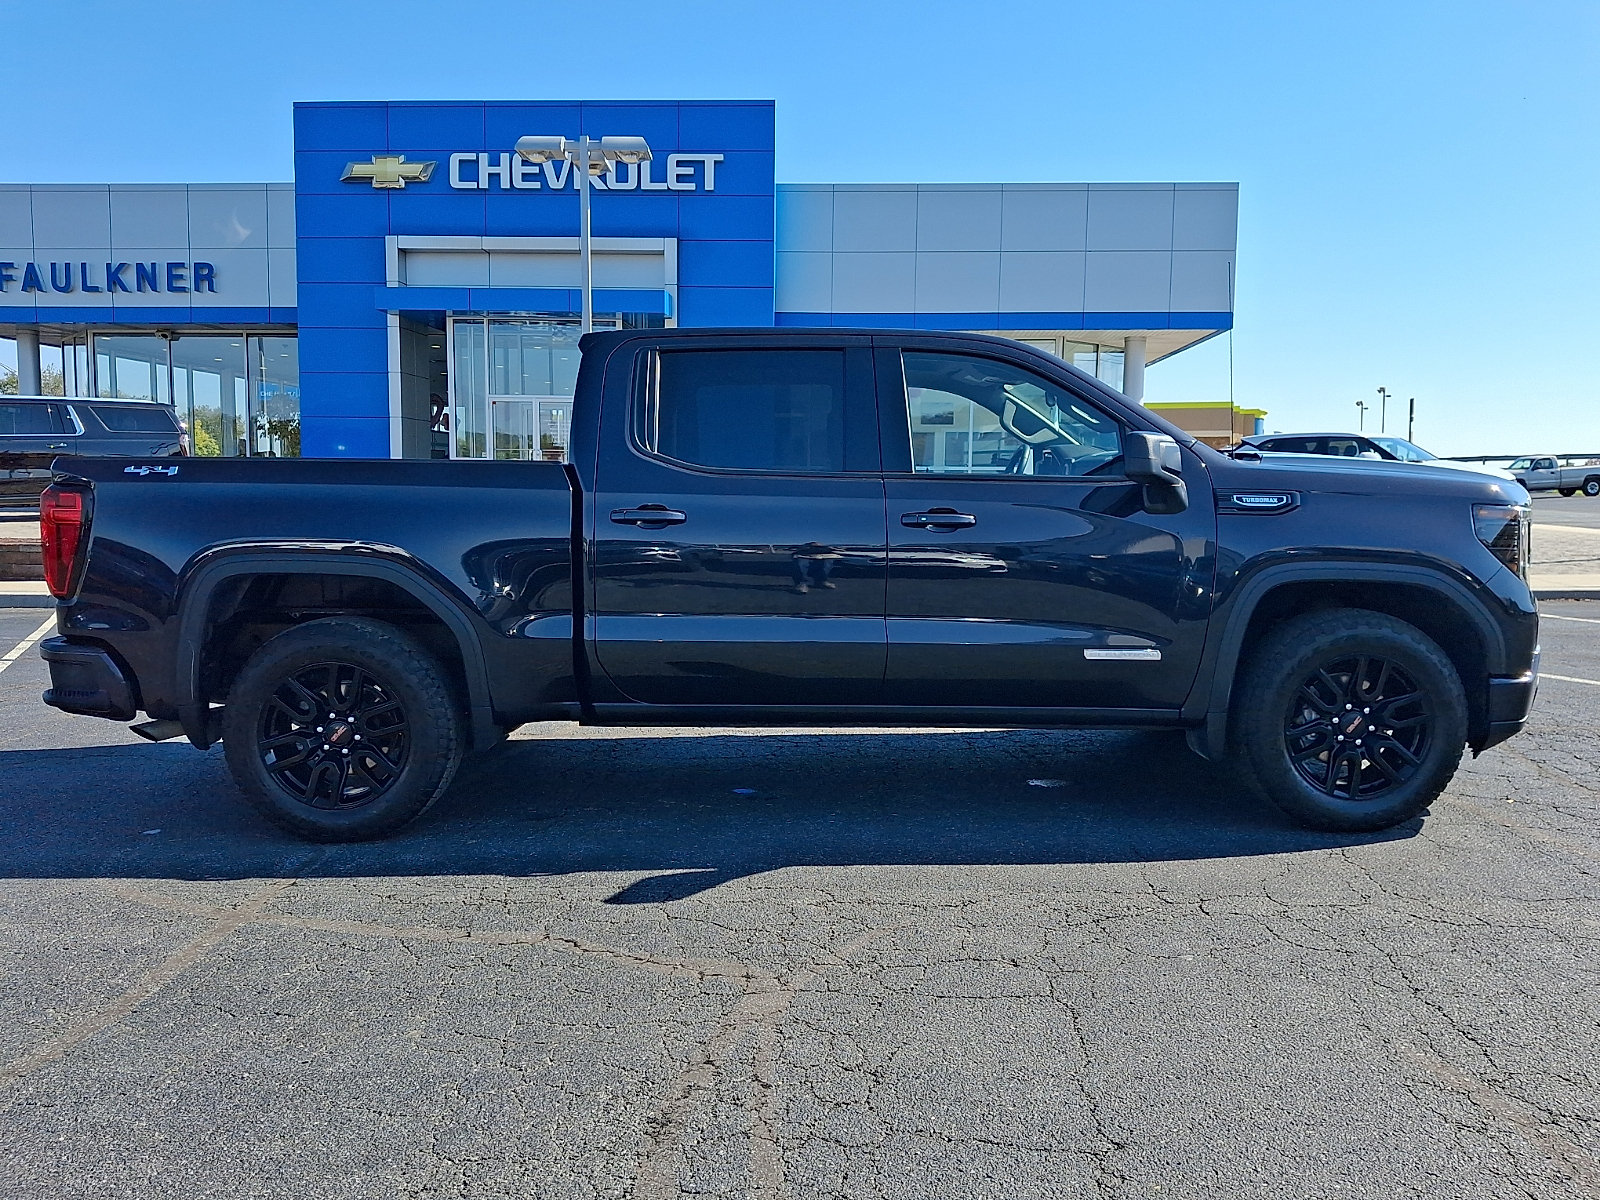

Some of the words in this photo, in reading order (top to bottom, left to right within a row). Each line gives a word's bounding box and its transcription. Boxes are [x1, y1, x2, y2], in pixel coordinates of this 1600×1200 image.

[0, 262, 217, 293] FAULKNER
[330, 725, 348, 742] GMC
[1345, 715, 1363, 734] GMC
